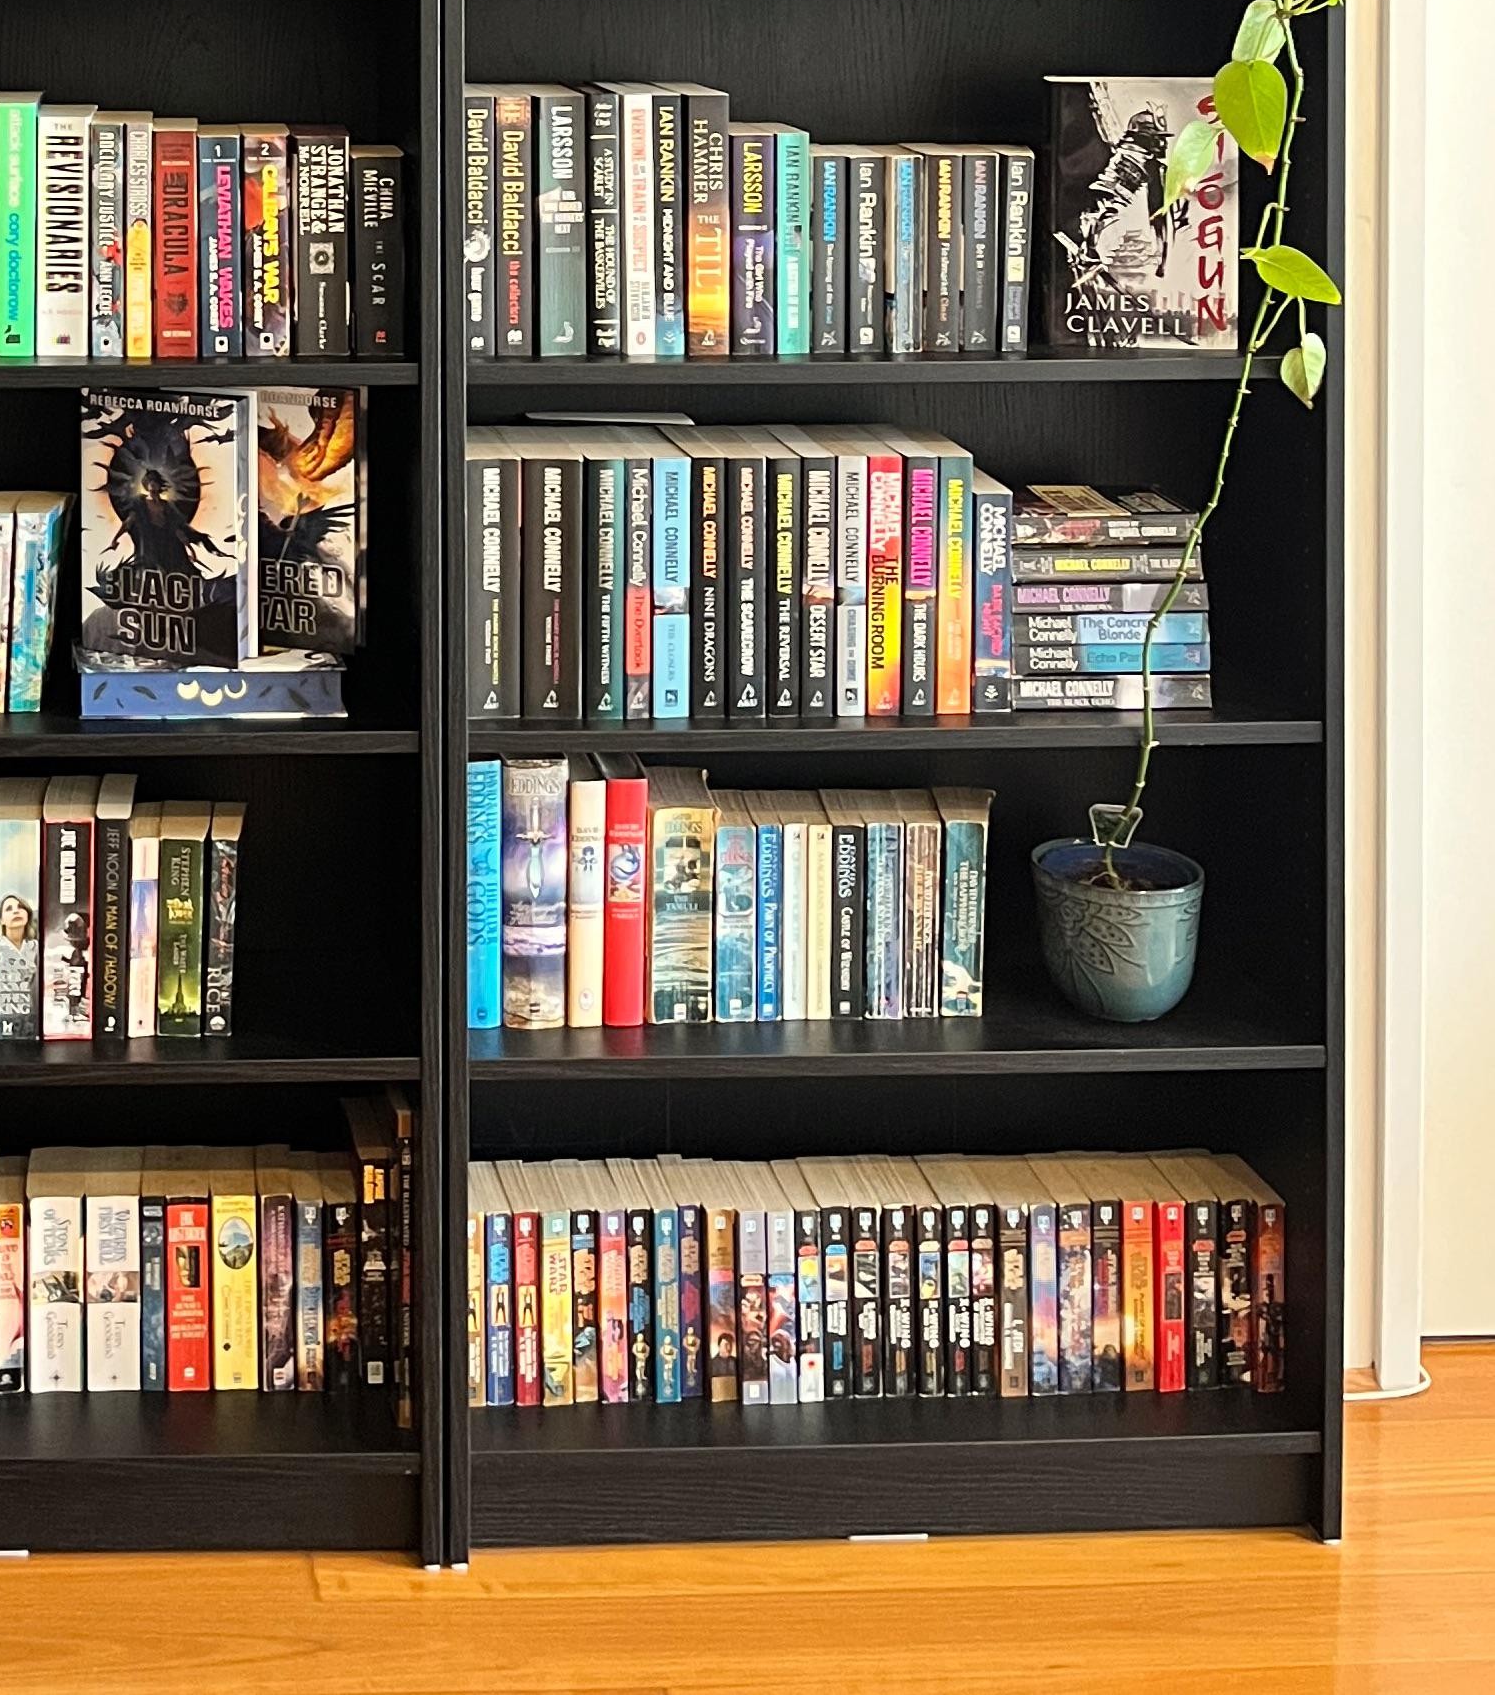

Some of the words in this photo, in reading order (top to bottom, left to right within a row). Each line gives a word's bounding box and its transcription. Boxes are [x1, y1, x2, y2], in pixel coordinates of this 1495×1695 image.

[467, 109, 487, 150] David
[694, 120, 708, 204] HAMMER
[860, 163, 873, 187] Ian
[467, 155, 488, 224] Baldacci
[9, 213, 18, 247] cory
[45, 136, 84, 294] REVISIONARIES
[163, 186, 188, 275] DRACULA
[860, 192, 876, 258] Rankin
[9, 249, 18, 322] doctorow
[373, 263, 386, 305] SCAR
[1064, 292, 1150, 314] JAMES
[1066, 316, 1186, 335] CLAVELL
[90, 394, 143, 410] REBECCA
[147, 400, 219, 418] ROANHORSE
[483, 468, 500, 525] MICHAEL
[483, 528, 500, 592] CONNELLY
[872, 555, 884, 620] BURNING
[119, 608, 196, 654] SUN
[1028, 617, 1072, 630] Michael
[1028, 628, 1077, 642] Connelly
[1099, 629, 1140, 640] Blonde
[872, 625, 885, 669] ROOM
[511, 779, 561, 794] EDDINGS
[207, 967, 219, 1013] RICE
